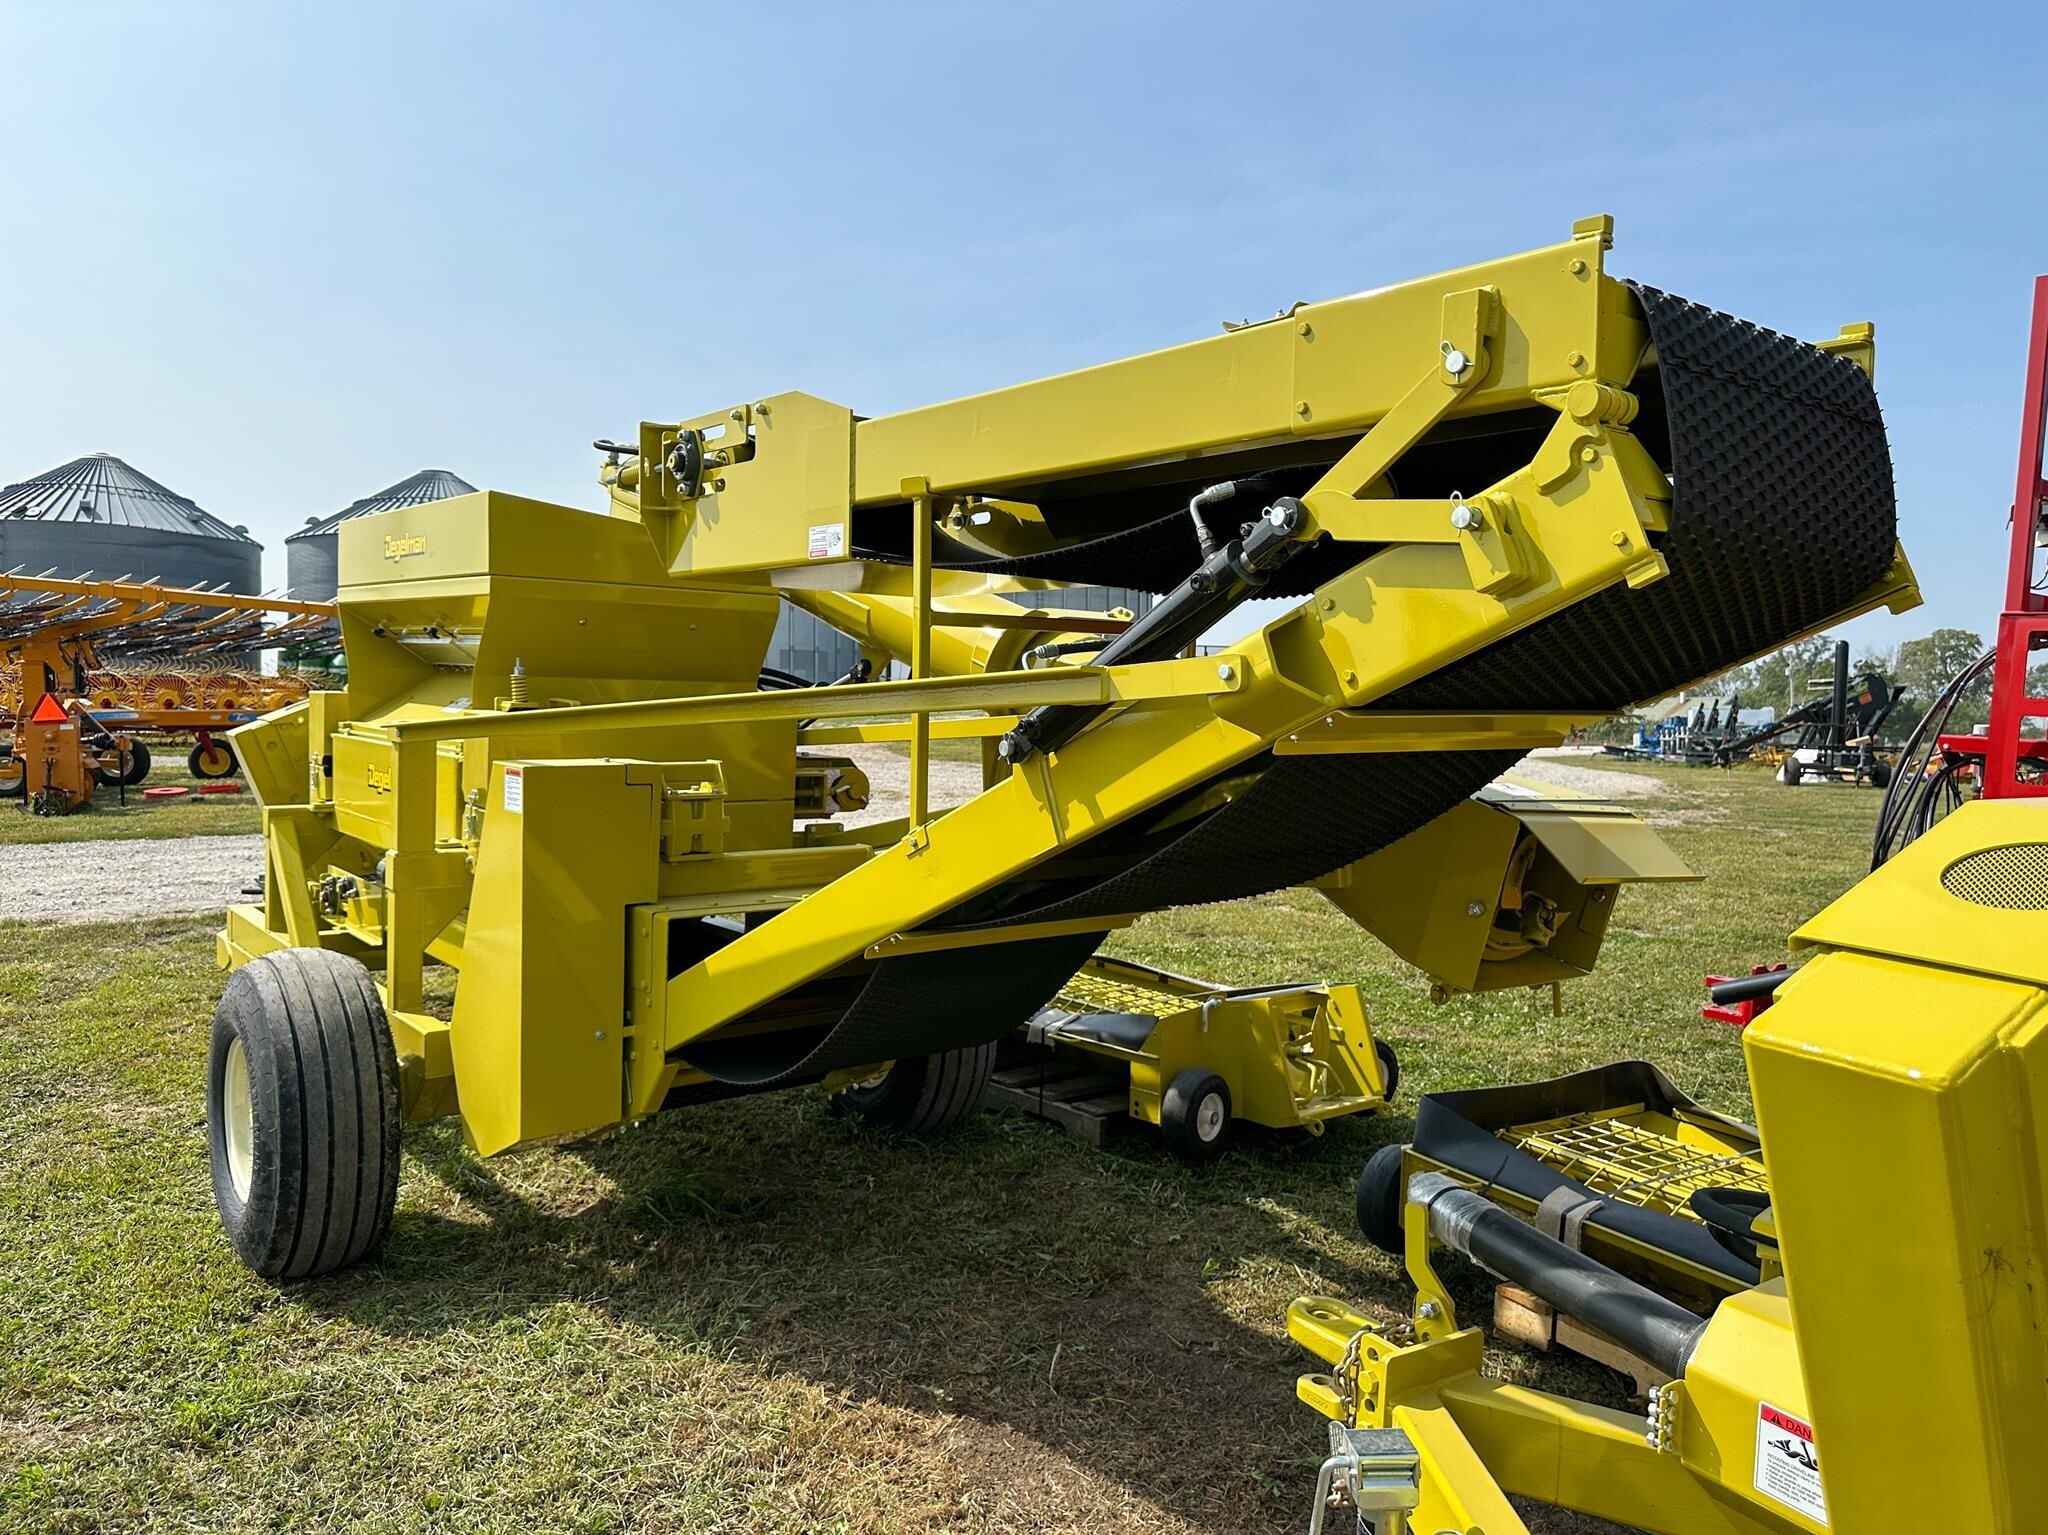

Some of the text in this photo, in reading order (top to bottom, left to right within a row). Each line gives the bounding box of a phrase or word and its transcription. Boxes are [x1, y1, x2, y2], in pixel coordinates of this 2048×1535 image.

[385, 532, 426, 563] Degelman
[368, 763, 392, 795] Degel
[1785, 1420, 1811, 1438] DAN
